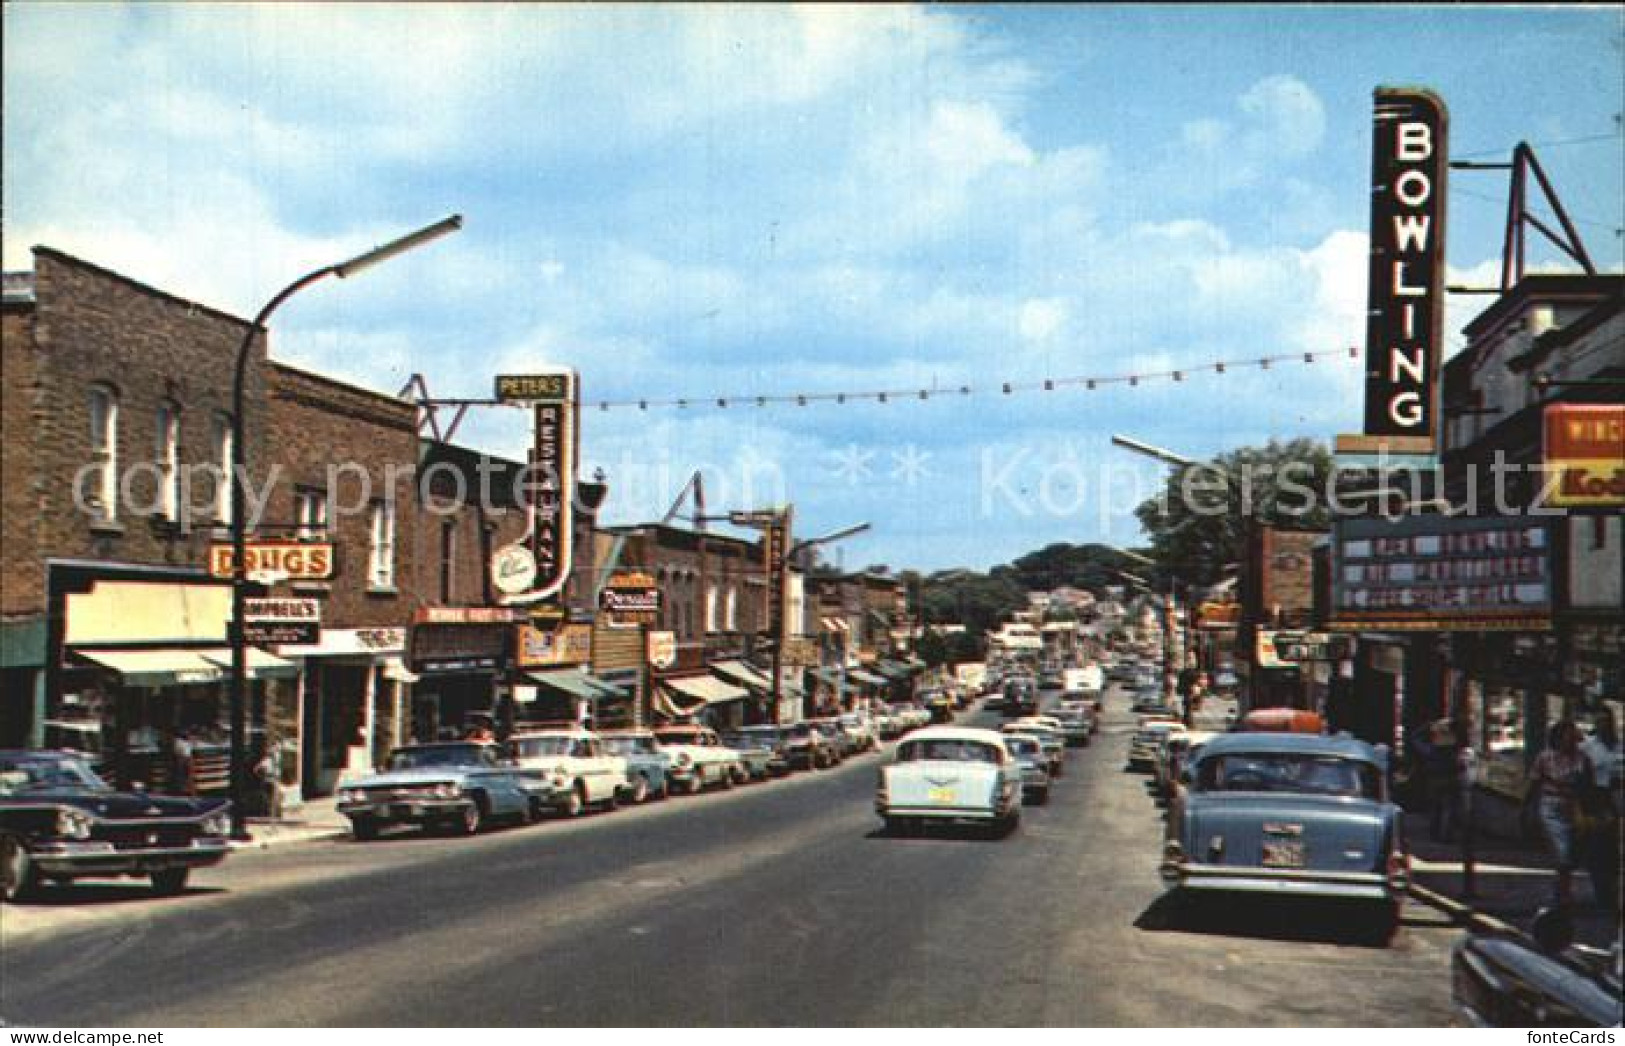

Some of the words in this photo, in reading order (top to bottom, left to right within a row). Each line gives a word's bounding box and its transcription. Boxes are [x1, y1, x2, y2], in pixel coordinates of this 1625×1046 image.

[1388, 122, 1433, 428] BOWLING
[218, 550, 328, 574] DRUGS
[540, 406, 557, 576] RESTAURANT
